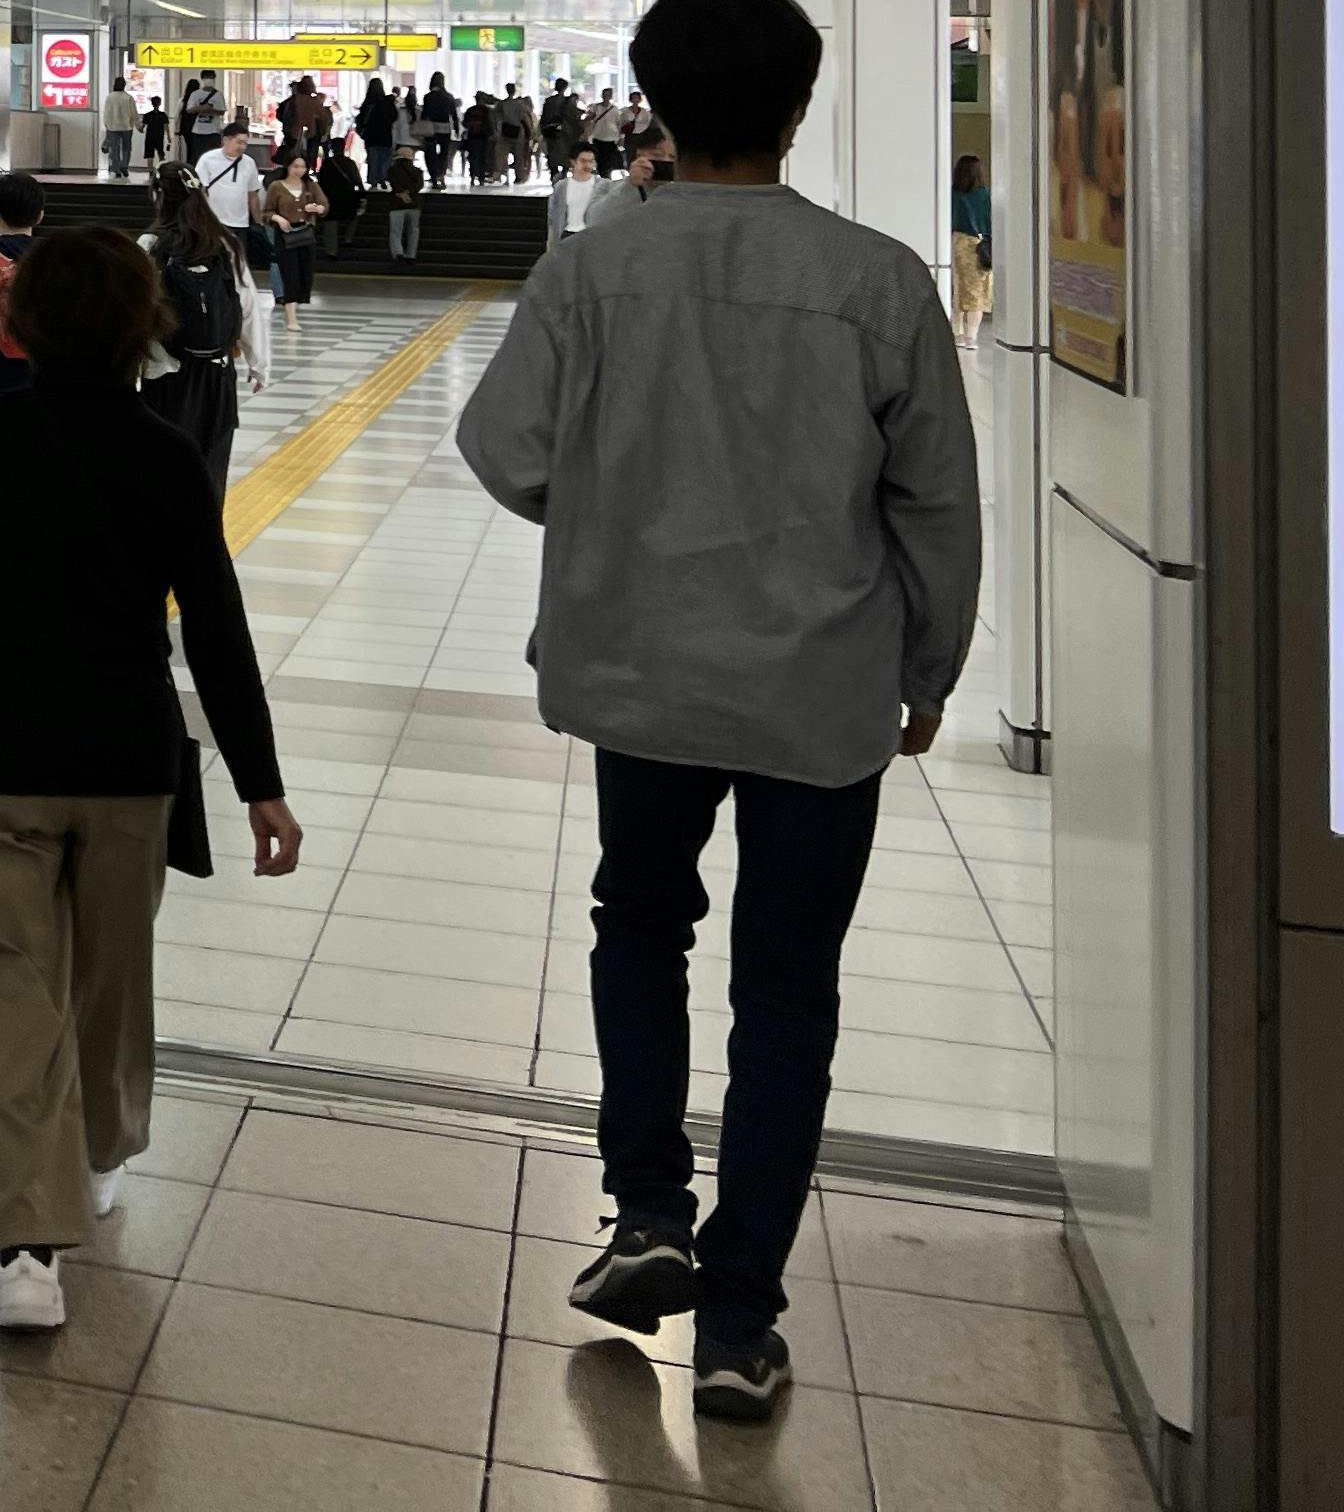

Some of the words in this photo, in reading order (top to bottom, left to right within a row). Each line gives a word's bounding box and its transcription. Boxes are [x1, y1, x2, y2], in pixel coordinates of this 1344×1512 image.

[50, 55, 83, 68] ガスト
[186, 47, 194, 64] 1
[335, 47, 347, 65] 2
